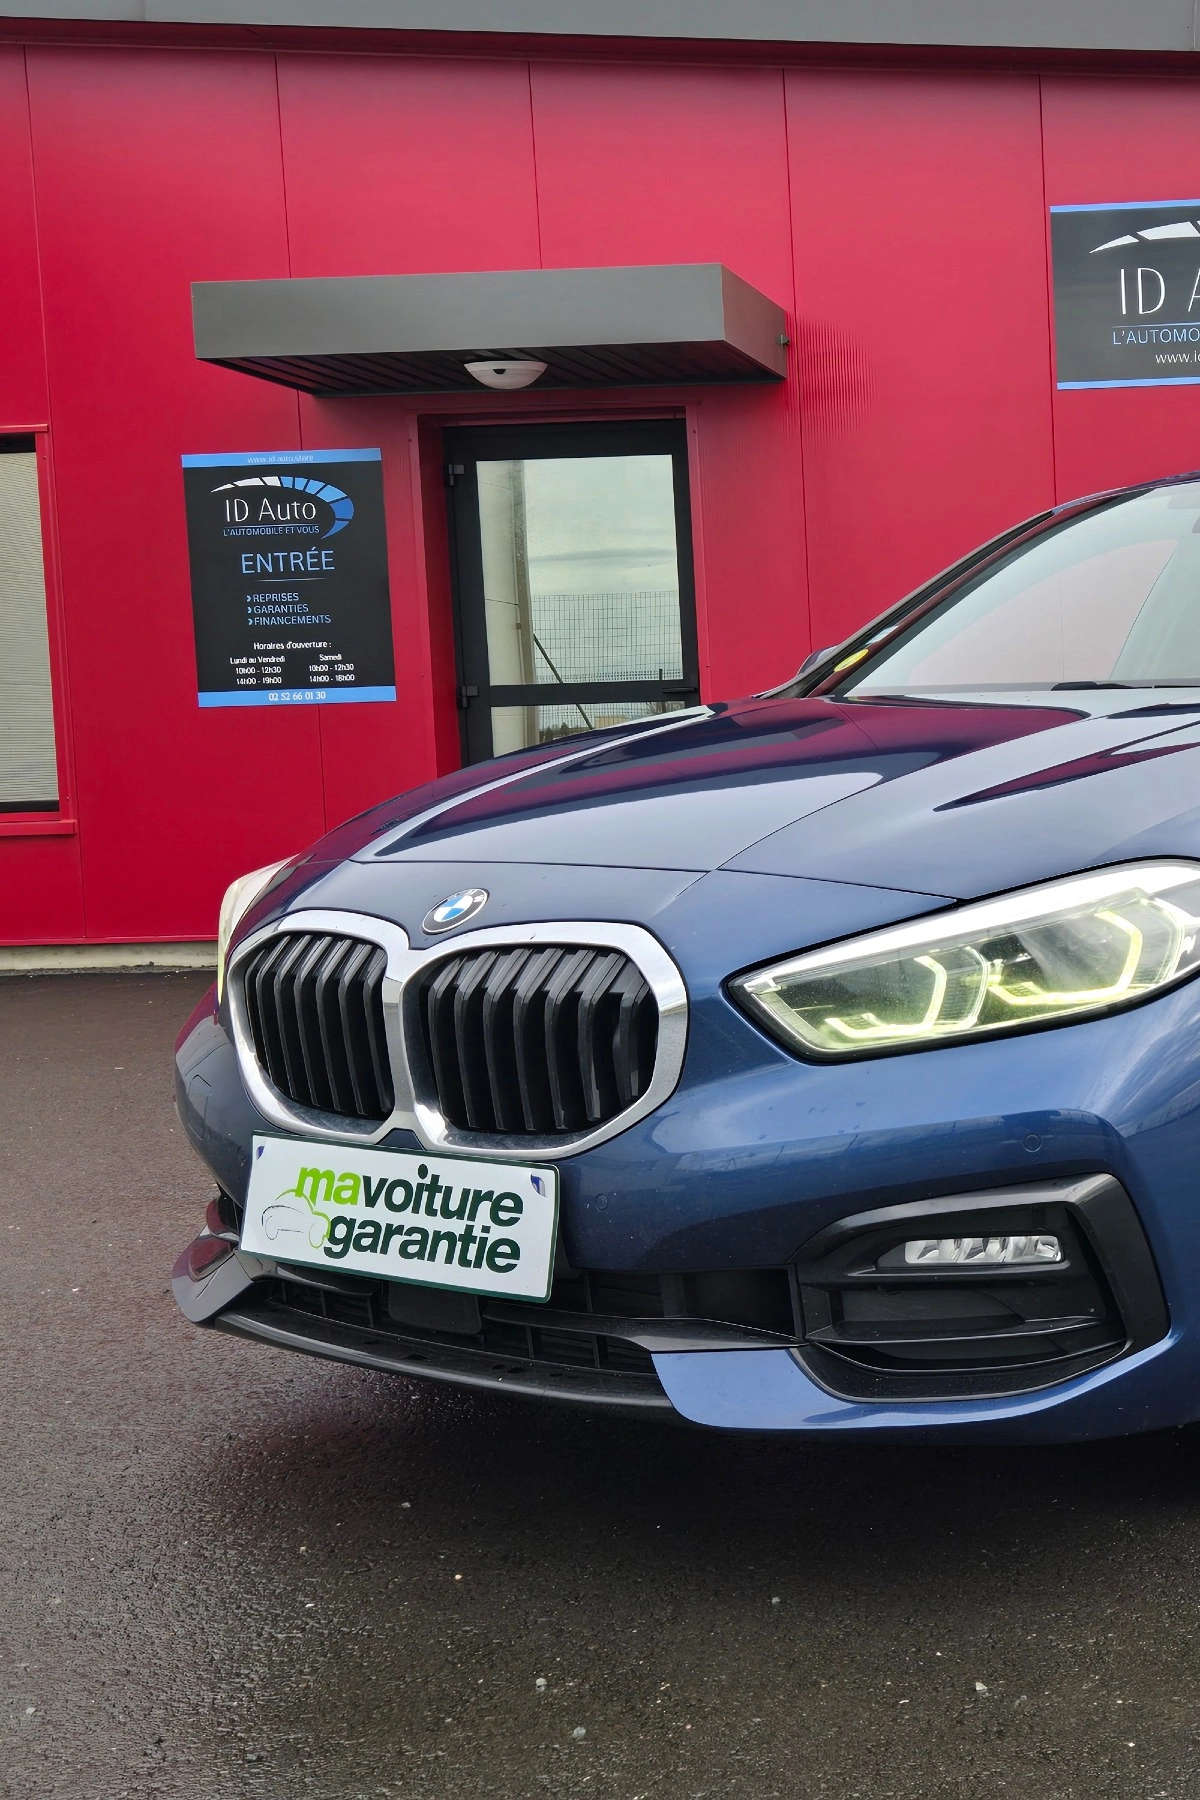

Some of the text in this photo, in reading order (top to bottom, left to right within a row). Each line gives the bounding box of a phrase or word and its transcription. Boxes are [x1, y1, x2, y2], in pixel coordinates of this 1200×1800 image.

[1120, 267, 1166, 315] ID
[226, 497, 316, 522] ID Auto
[223, 525, 320, 536] L'AUTOMOBILE ET VOUS
[241, 546, 335, 574] ENTRÉE
[253, 592, 299, 602] REPRISES
[253, 603, 309, 614] GARANTIES
[254, 614, 332, 626] FINANCEMENTS
[253, 642, 285, 650] Horaires
[258, 655, 285, 663] Vendredi
[319, 653, 342, 661] Samedi
[268, 692, 279, 701] 02
[292, 692, 303, 700] 66
[315, 691, 326, 700] 30
[323, 1214, 522, 1275] garantie
